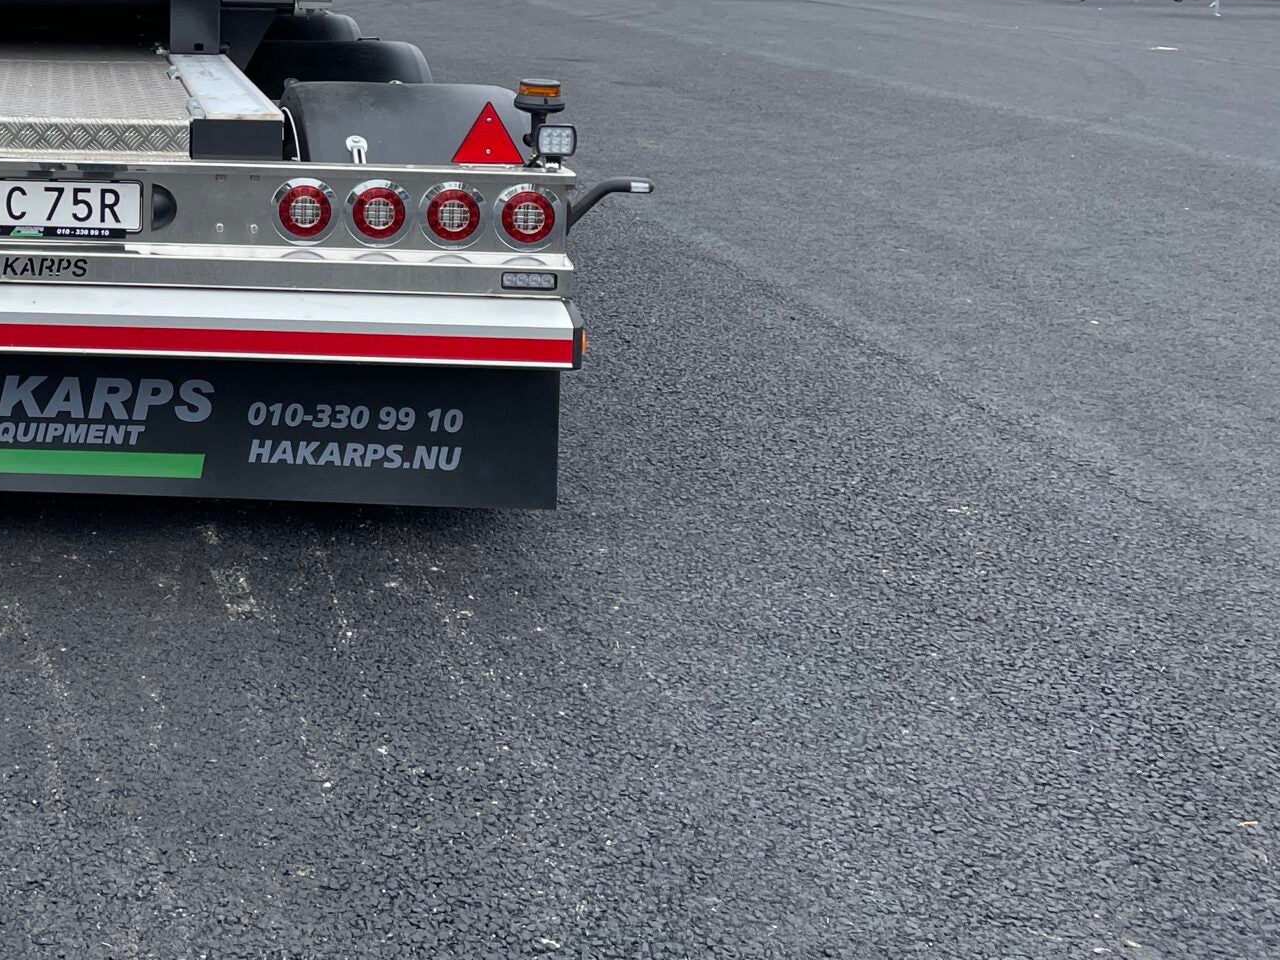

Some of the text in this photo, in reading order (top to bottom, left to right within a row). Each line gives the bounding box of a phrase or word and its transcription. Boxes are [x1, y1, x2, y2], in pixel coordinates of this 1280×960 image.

[43, 186, 121, 224] 75R
[247, 401, 464, 433] 010-330 99 10
[248, 439, 462, 471] HAKARPS.NU
